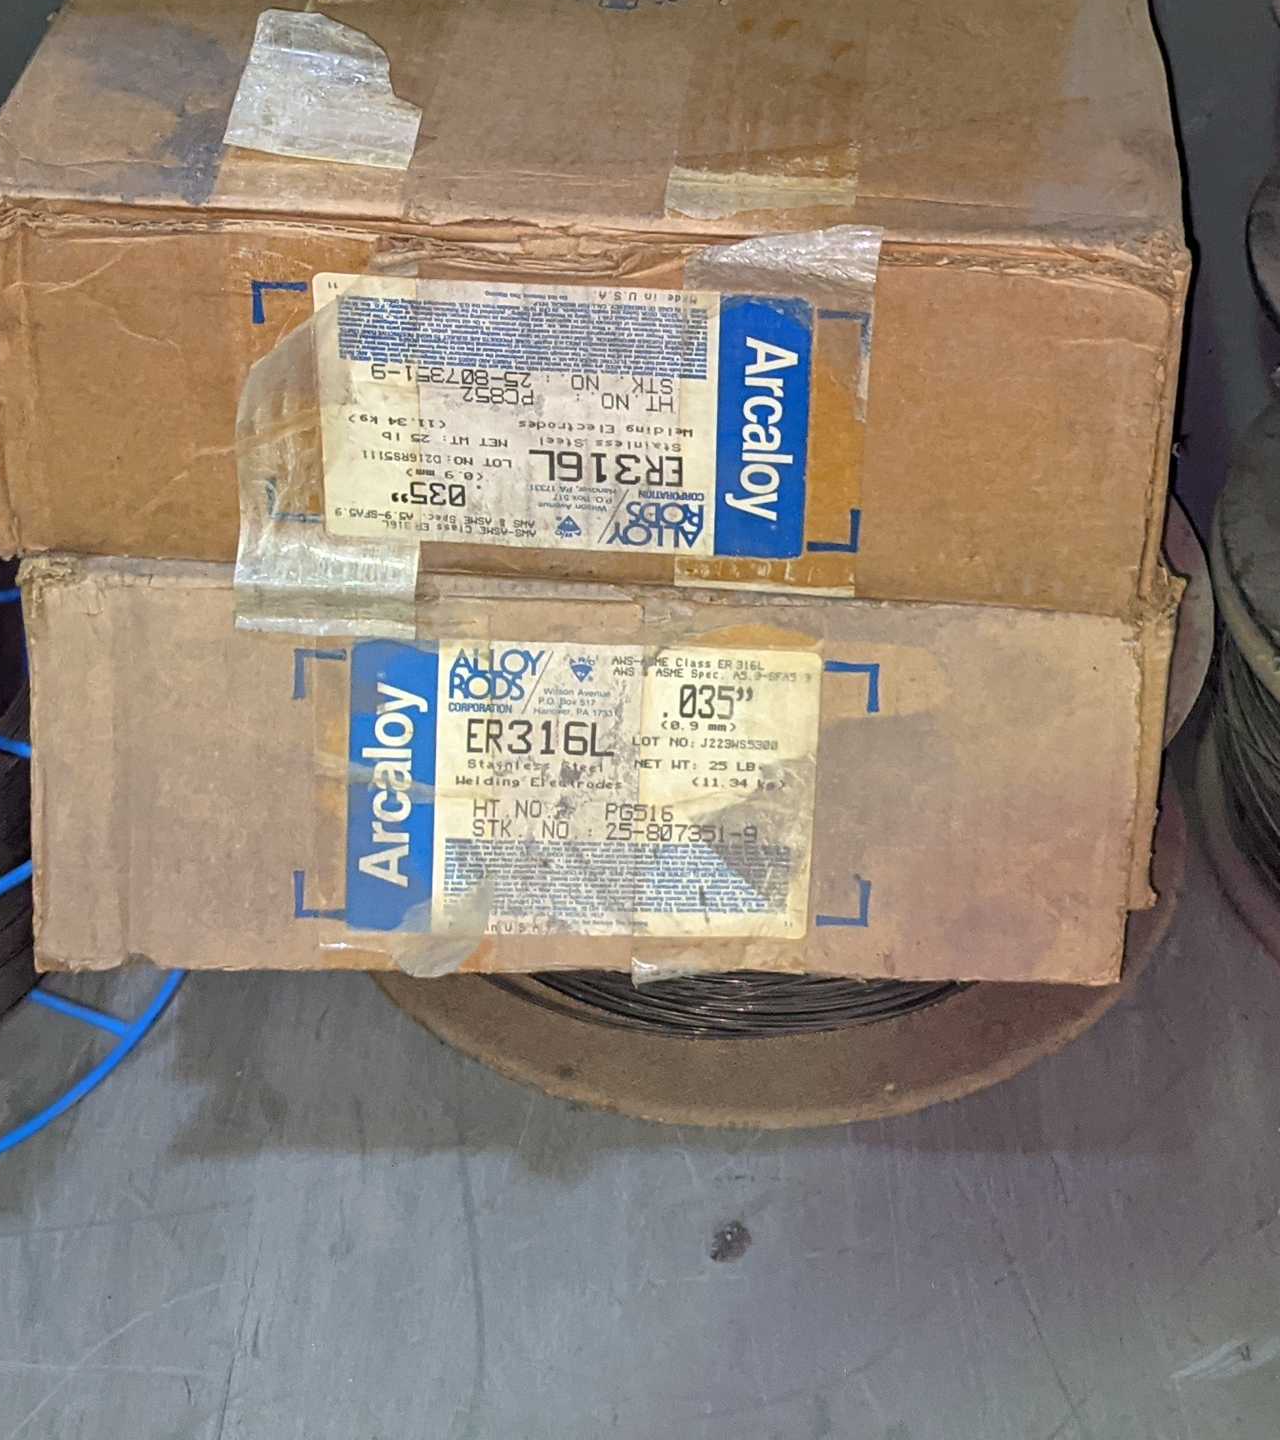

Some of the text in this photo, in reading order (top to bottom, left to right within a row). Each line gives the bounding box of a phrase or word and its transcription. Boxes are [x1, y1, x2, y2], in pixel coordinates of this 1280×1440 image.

[592, 290, 637, 301] U.S.A.
[644, 293, 657, 302] in
[370, 363, 532, 387] 25-807351-9
[459, 386, 535, 407] PC852
[518, 420, 694, 438] Welding Electrodes
[726, 336, 798, 521] Arcaloy
[381, 431, 508, 447] NET WT: 25 lb
[539, 437, 682, 452] Stainless Steel
[446, 455, 473, 467] NO:
[482, 457, 512, 468] LOT
[529, 449, 683, 487] ER316L
[559, 485, 573, 494] PA
[638, 490, 704, 501] CORPORATION
[553, 494, 570, 502] 517
[573, 495, 590, 503] Box
[537, 502, 573, 511] Avenue
[334, 507, 414, 520] A5.9-SFA5.9
[422, 513, 457, 525] Spec.
[625, 501, 704, 530] RODS
[463, 515, 492, 525] ASME
[513, 519, 535, 529] AWS
[436, 522, 473, 533] Class
[479, 525, 536, 538] AWS-ASME
[606, 522, 702, 549] ALLOY
[450, 648, 545, 676] ALLOY
[675, 658, 711, 669] Class
[613, 666, 635, 676] AWS
[655, 668, 684, 678] ASME
[691, 669, 724, 680] Spec.
[448, 671, 525, 701] RODS
[577, 689, 611, 698] Avenue
[448, 702, 512, 714] CORPORATION
[579, 699, 596, 707] 517
[576, 709, 590, 717] PA
[466, 718, 615, 757] ER316L
[631, 736, 661, 746] LOT
[669, 738, 695, 748] NO:
[634, 759, 663, 769] NET
[671, 760, 698, 770] WT:
[708, 761, 729, 771] 25
[358, 682, 428, 888] Arcaloy
[455, 775, 520, 788] Welding
[604, 803, 674, 822] PG516
[605, 822, 759, 843] 25-807351-9
